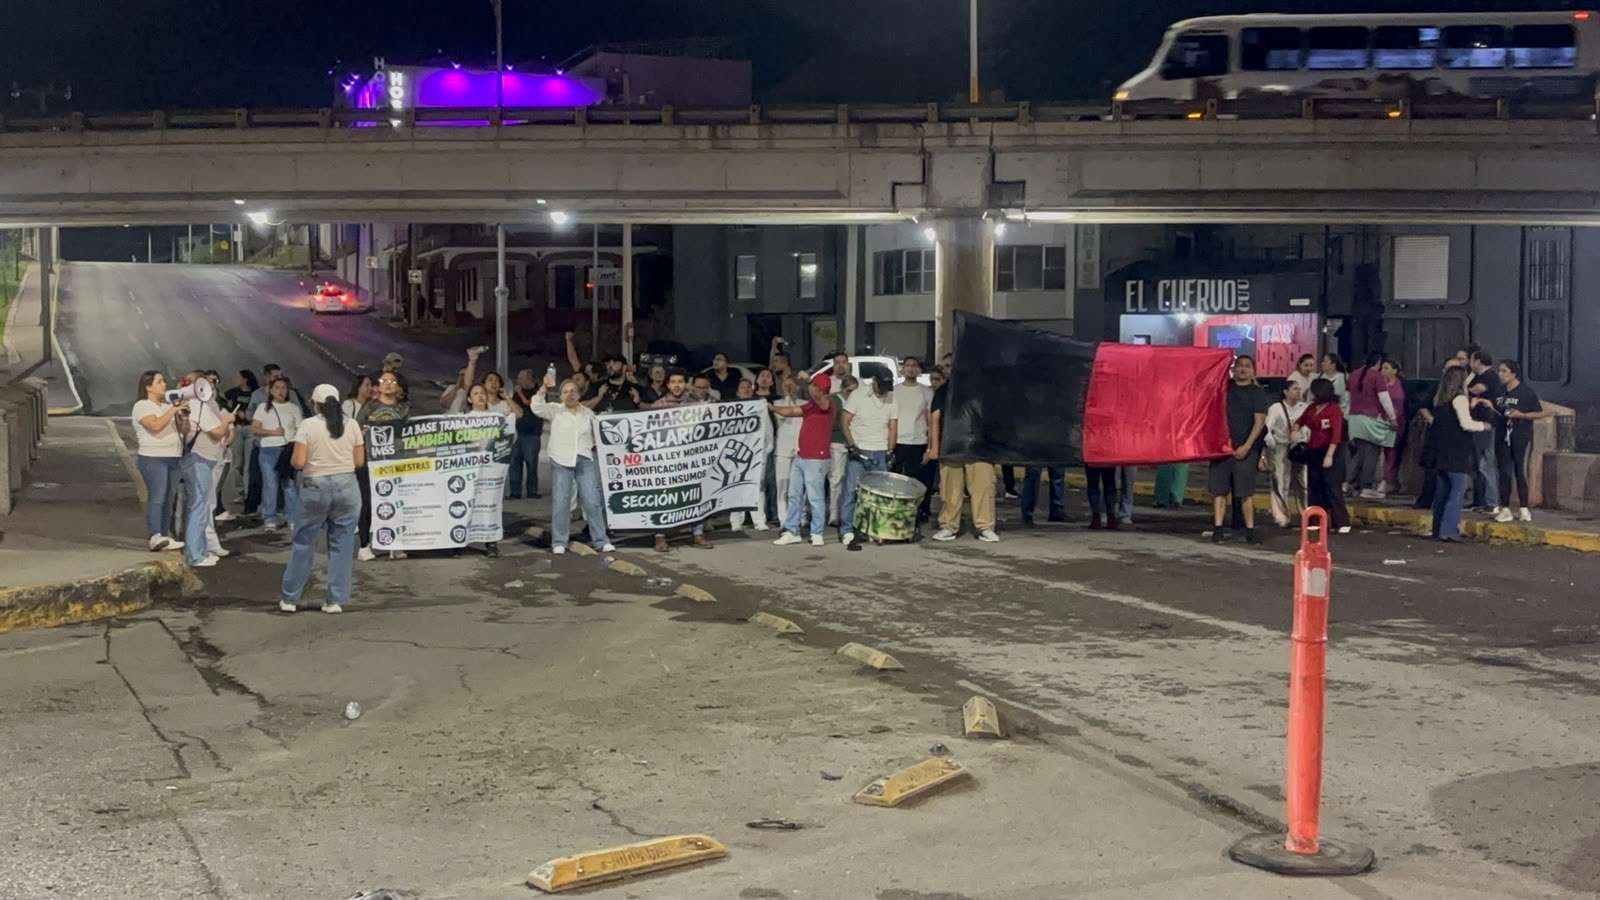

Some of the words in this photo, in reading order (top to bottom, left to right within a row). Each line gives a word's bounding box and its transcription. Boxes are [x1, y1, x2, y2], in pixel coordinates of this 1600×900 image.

[1126, 280, 1148, 312] EL
[1157, 279, 1236, 312] CUERVO
[1237, 279, 1250, 312] CUU
[401, 426, 414, 438] LA
[414, 423, 438, 435] BASE
[439, 416, 500, 432] TRABAJADORA
[646, 407, 713, 430] MARCHA
[718, 403, 745, 418] POR
[455, 426, 501, 443] CUENTA
[631, 424, 706, 452] SALARIO
[707, 417, 757, 437] DIGNO
[371, 445, 395, 457] IMSS
[623, 453, 641, 466] NO
[652, 453, 664, 462] LA
[665, 450, 682, 461] LEY
[683, 443, 719, 457] MORDAZA
[394, 461, 431, 474] NUESTRAS
[435, 454, 491, 471] DEMANDAS
[690, 460, 700, 469] AL
[626, 478, 653, 488] FALTA
[655, 477, 666, 486] DE
[669, 470, 707, 485] INSUMOS
[621, 490, 678, 509] SECCIÓN
[681, 487, 700, 502] VIII
